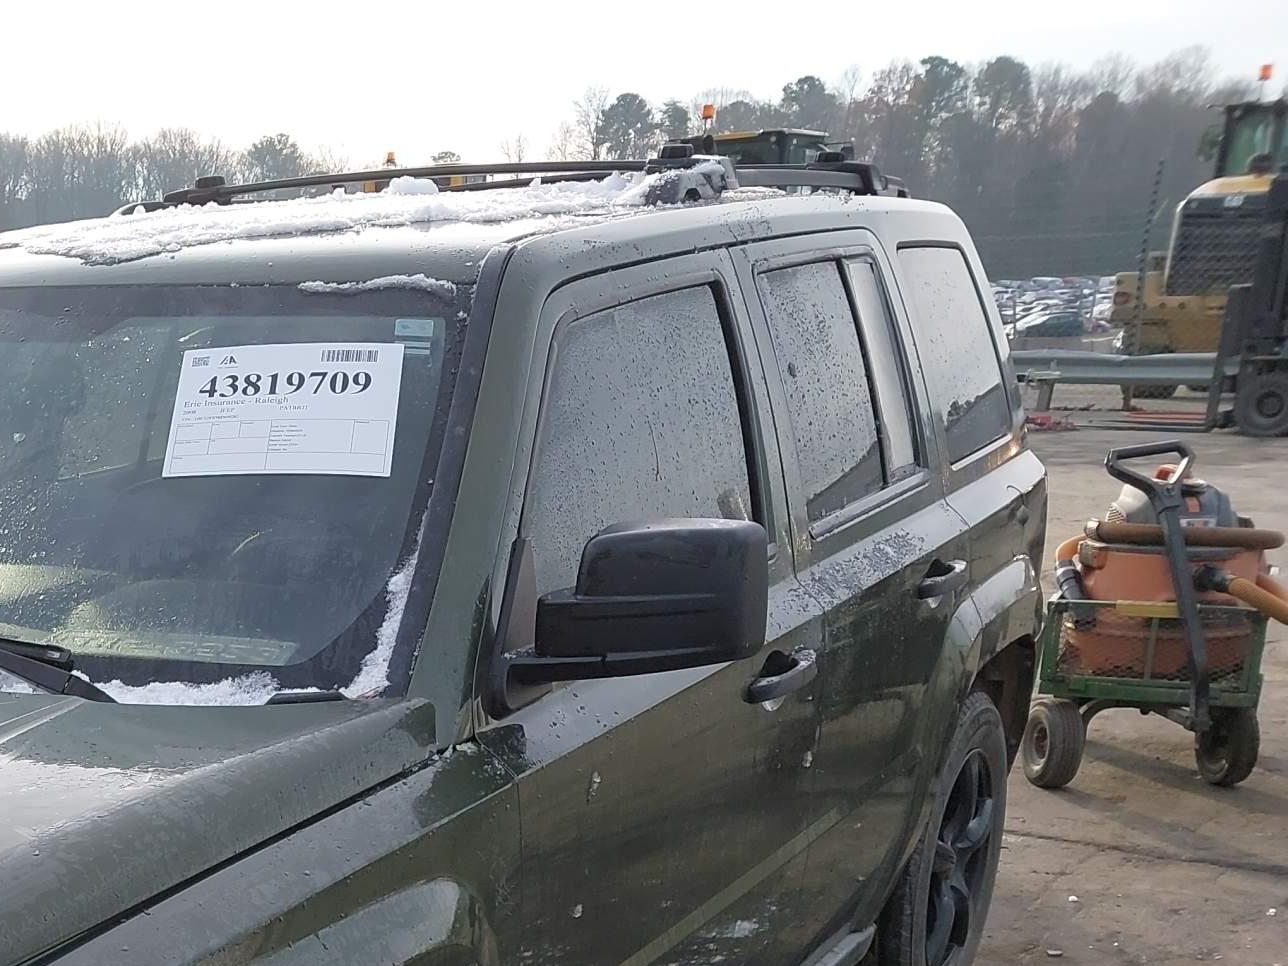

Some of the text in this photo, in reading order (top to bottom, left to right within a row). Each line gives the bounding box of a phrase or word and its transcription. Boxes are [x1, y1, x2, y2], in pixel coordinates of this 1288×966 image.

[198, 370, 373, 398] 43819709
[183, 400, 202, 409] Erie
[204, 397, 246, 408] Insurance
[254, 396, 289, 406] Raleigh
